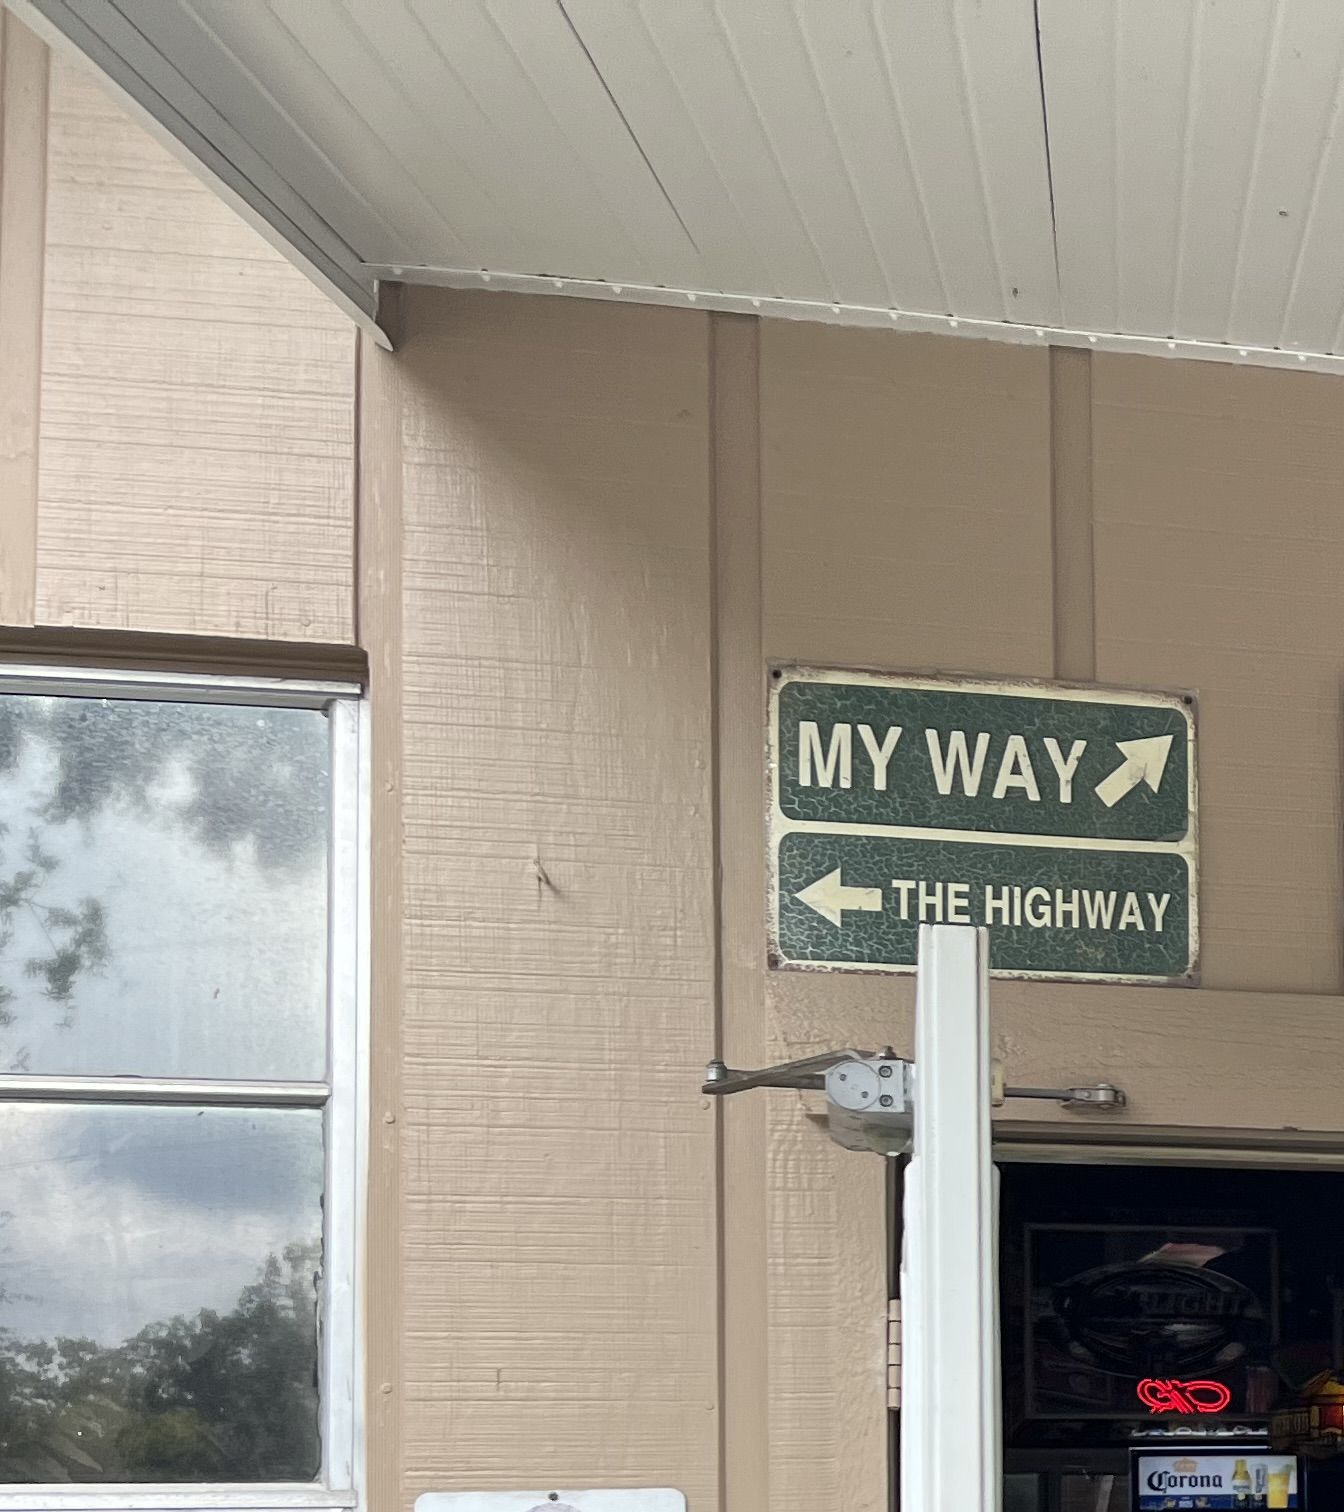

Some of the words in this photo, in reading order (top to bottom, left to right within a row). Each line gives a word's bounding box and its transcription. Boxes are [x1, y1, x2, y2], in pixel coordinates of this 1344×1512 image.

[799, 721, 902, 790] MY
[925, 728, 1087, 803] WAY
[891, 879, 970, 924] THE
[984, 884, 1171, 932] HIGHWAY
[1147, 1470, 1223, 1493] Corona
